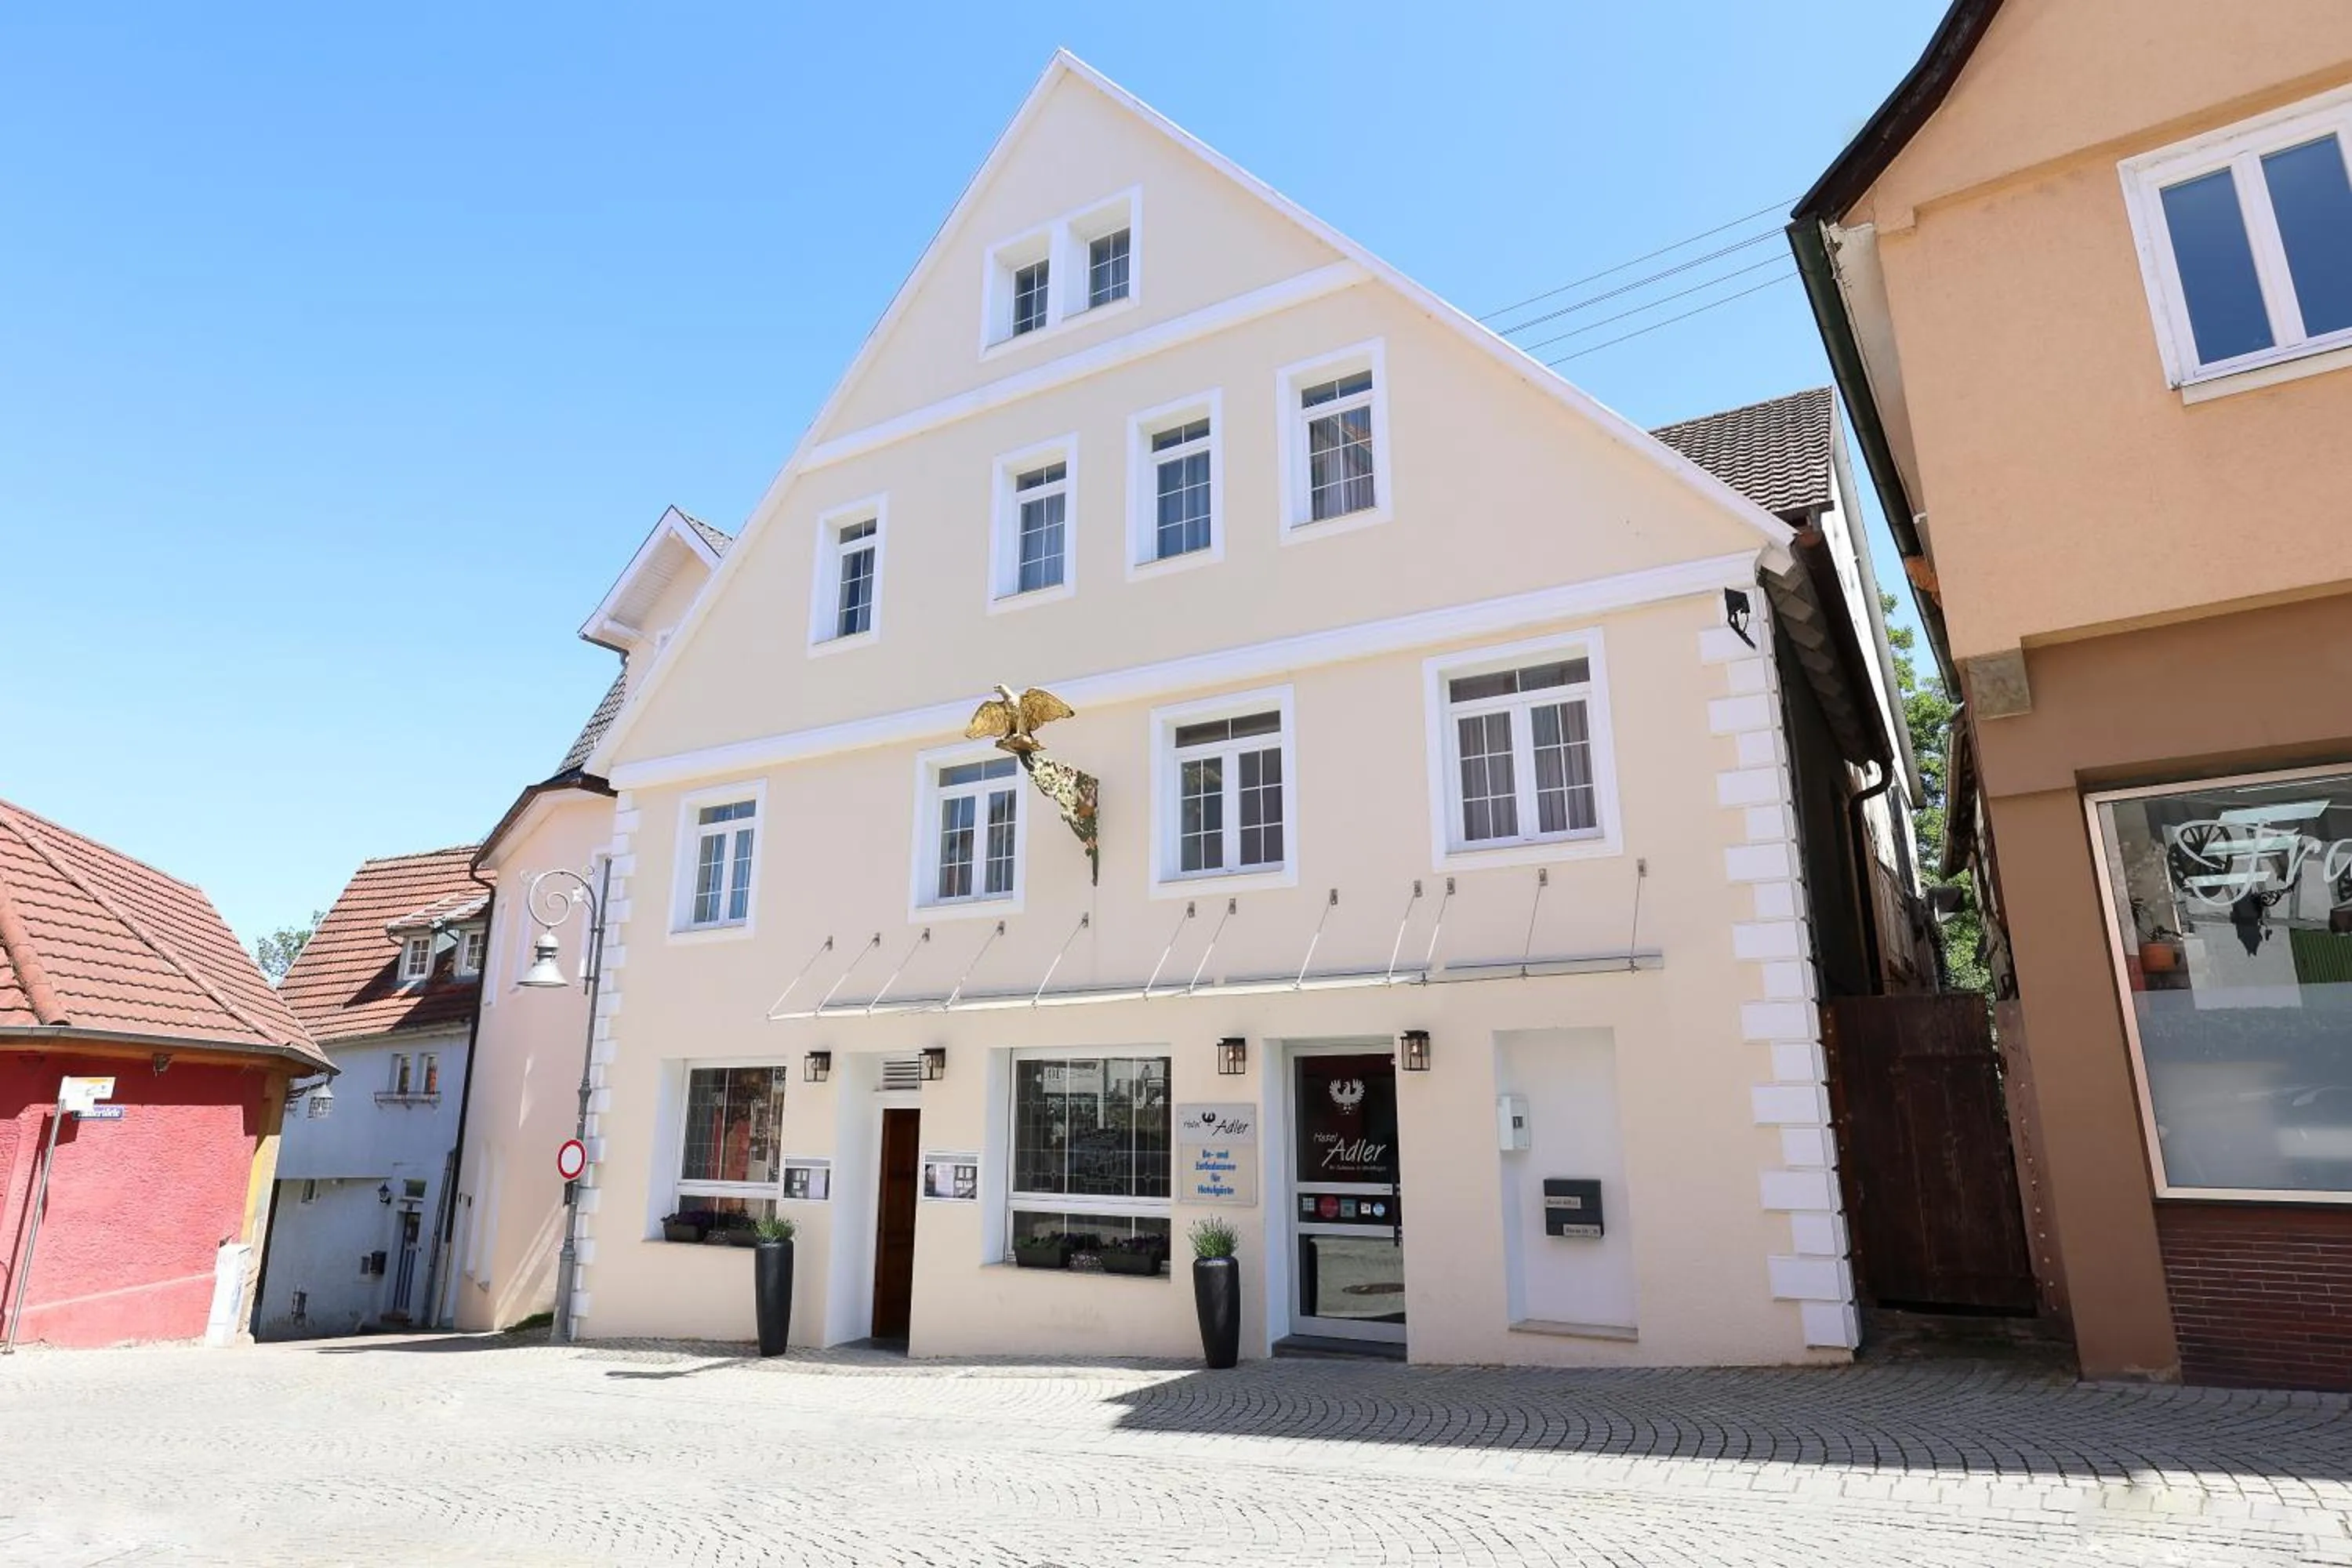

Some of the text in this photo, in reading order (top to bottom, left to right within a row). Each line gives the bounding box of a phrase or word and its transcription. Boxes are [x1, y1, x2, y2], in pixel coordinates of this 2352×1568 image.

[1211, 1119, 1249, 1136] Adler
[1313, 1131, 1387, 1167] Hotel Adler
